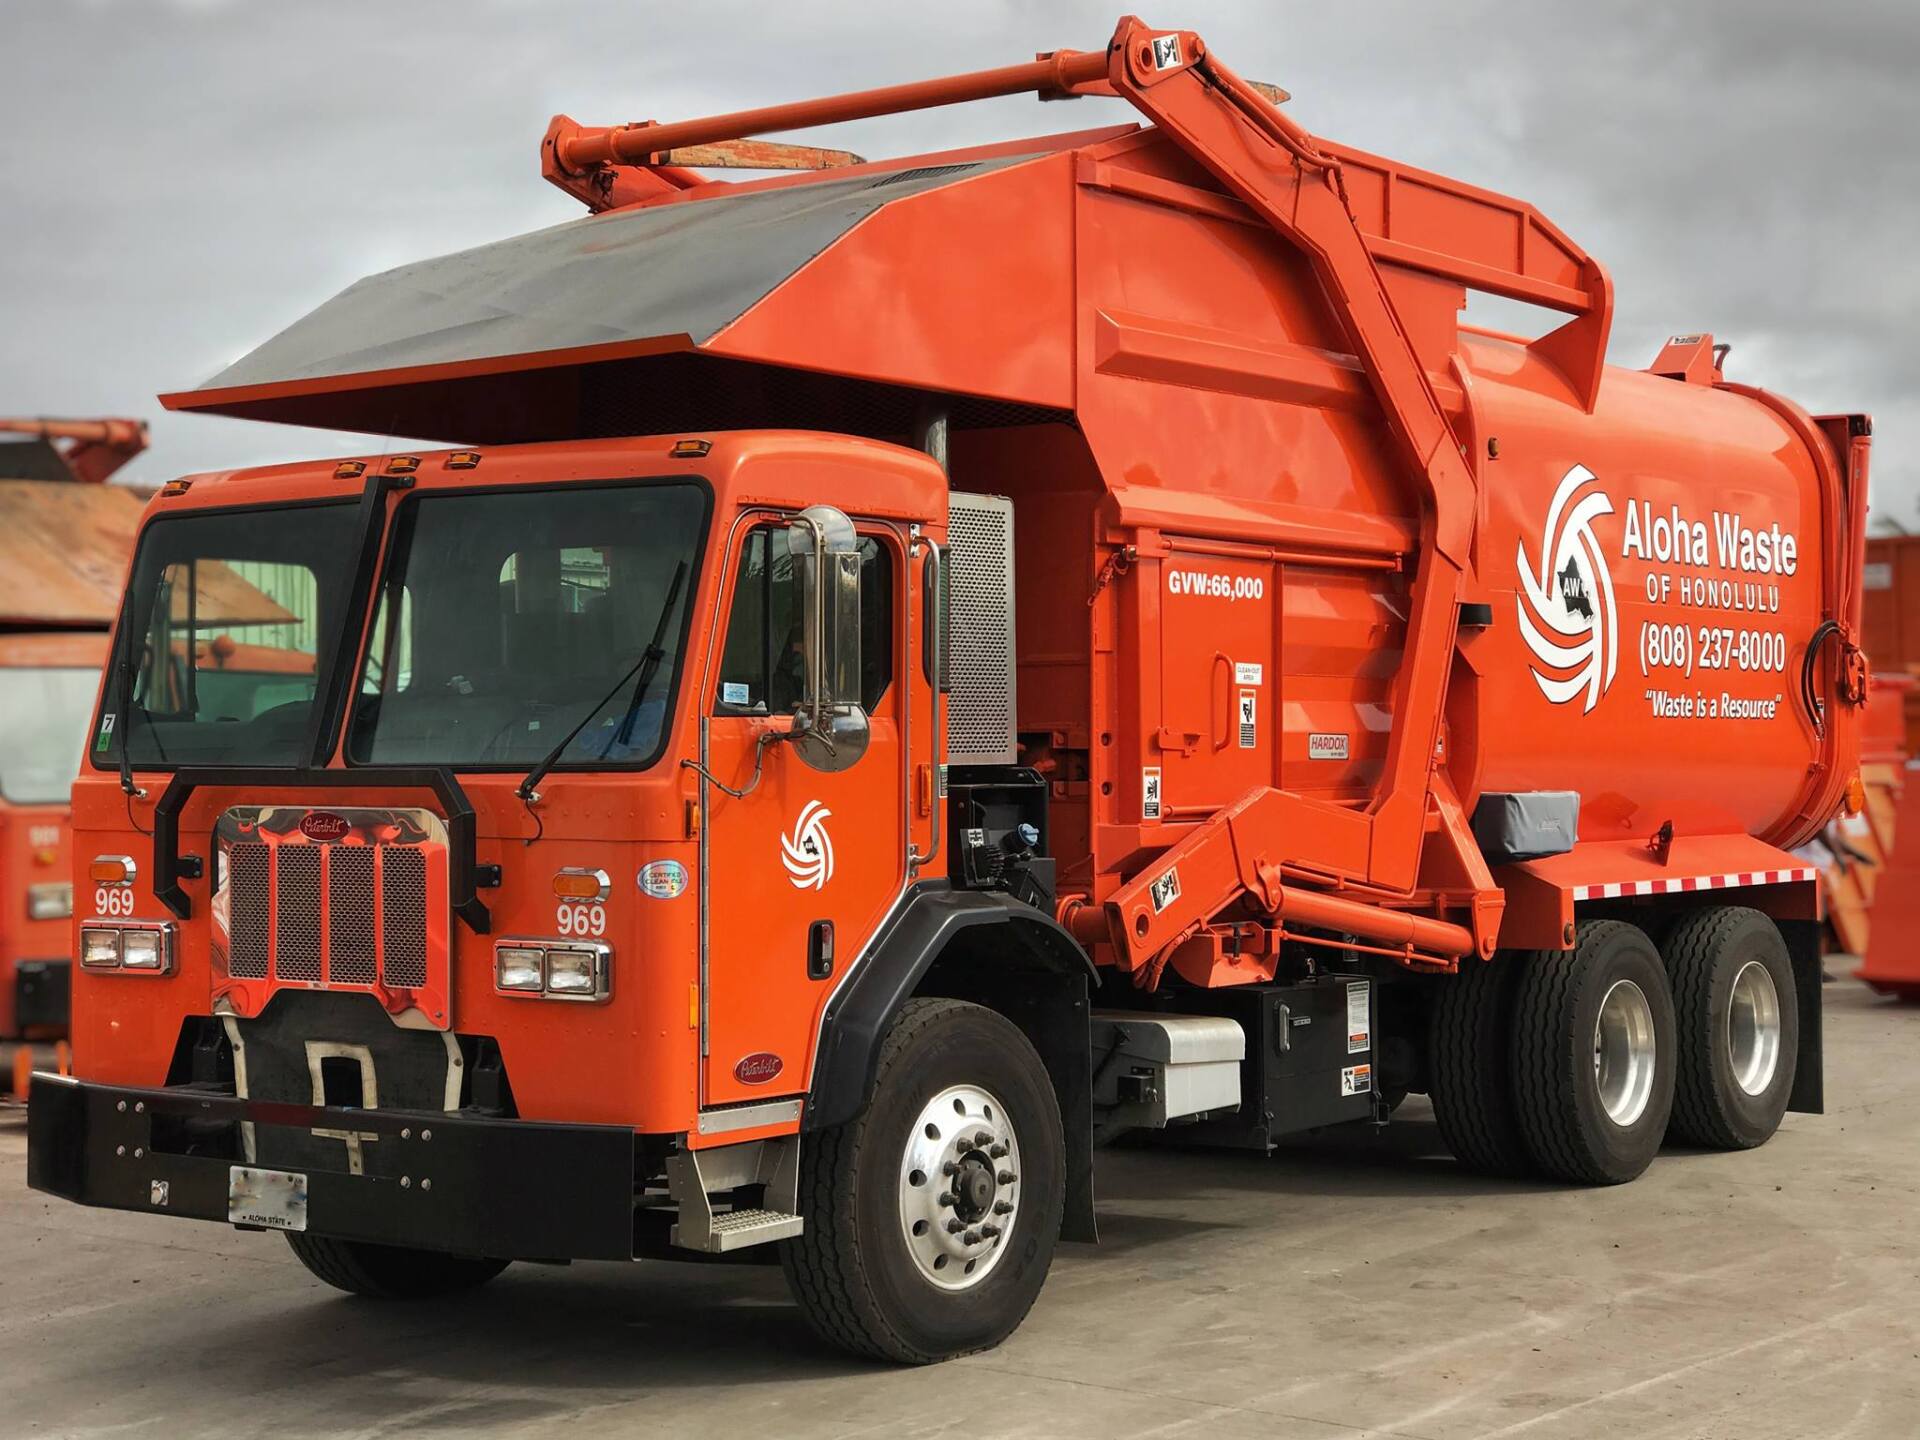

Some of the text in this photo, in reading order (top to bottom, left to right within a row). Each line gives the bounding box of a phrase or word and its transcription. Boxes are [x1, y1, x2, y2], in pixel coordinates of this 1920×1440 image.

[1622, 498, 1798, 576] Aloha Waste
[1168, 570, 1264, 602] GVW:66,000
[1646, 572, 1780, 613] OF HONOLULU
[1639, 620, 1786, 679] (808) 237-8000
[1696, 691, 1707, 718] is
[1709, 698, 1718, 718] a
[105, 717, 113, 730] 7
[1311, 736, 1346, 750] HARDOX
[304, 816, 345, 833] Peterbilt
[95, 888, 134, 916] 969
[556, 904, 606, 936] 969
[740, 1059, 779, 1078] Peterbilt
[249, 1214, 286, 1225] ALOHA STATE
